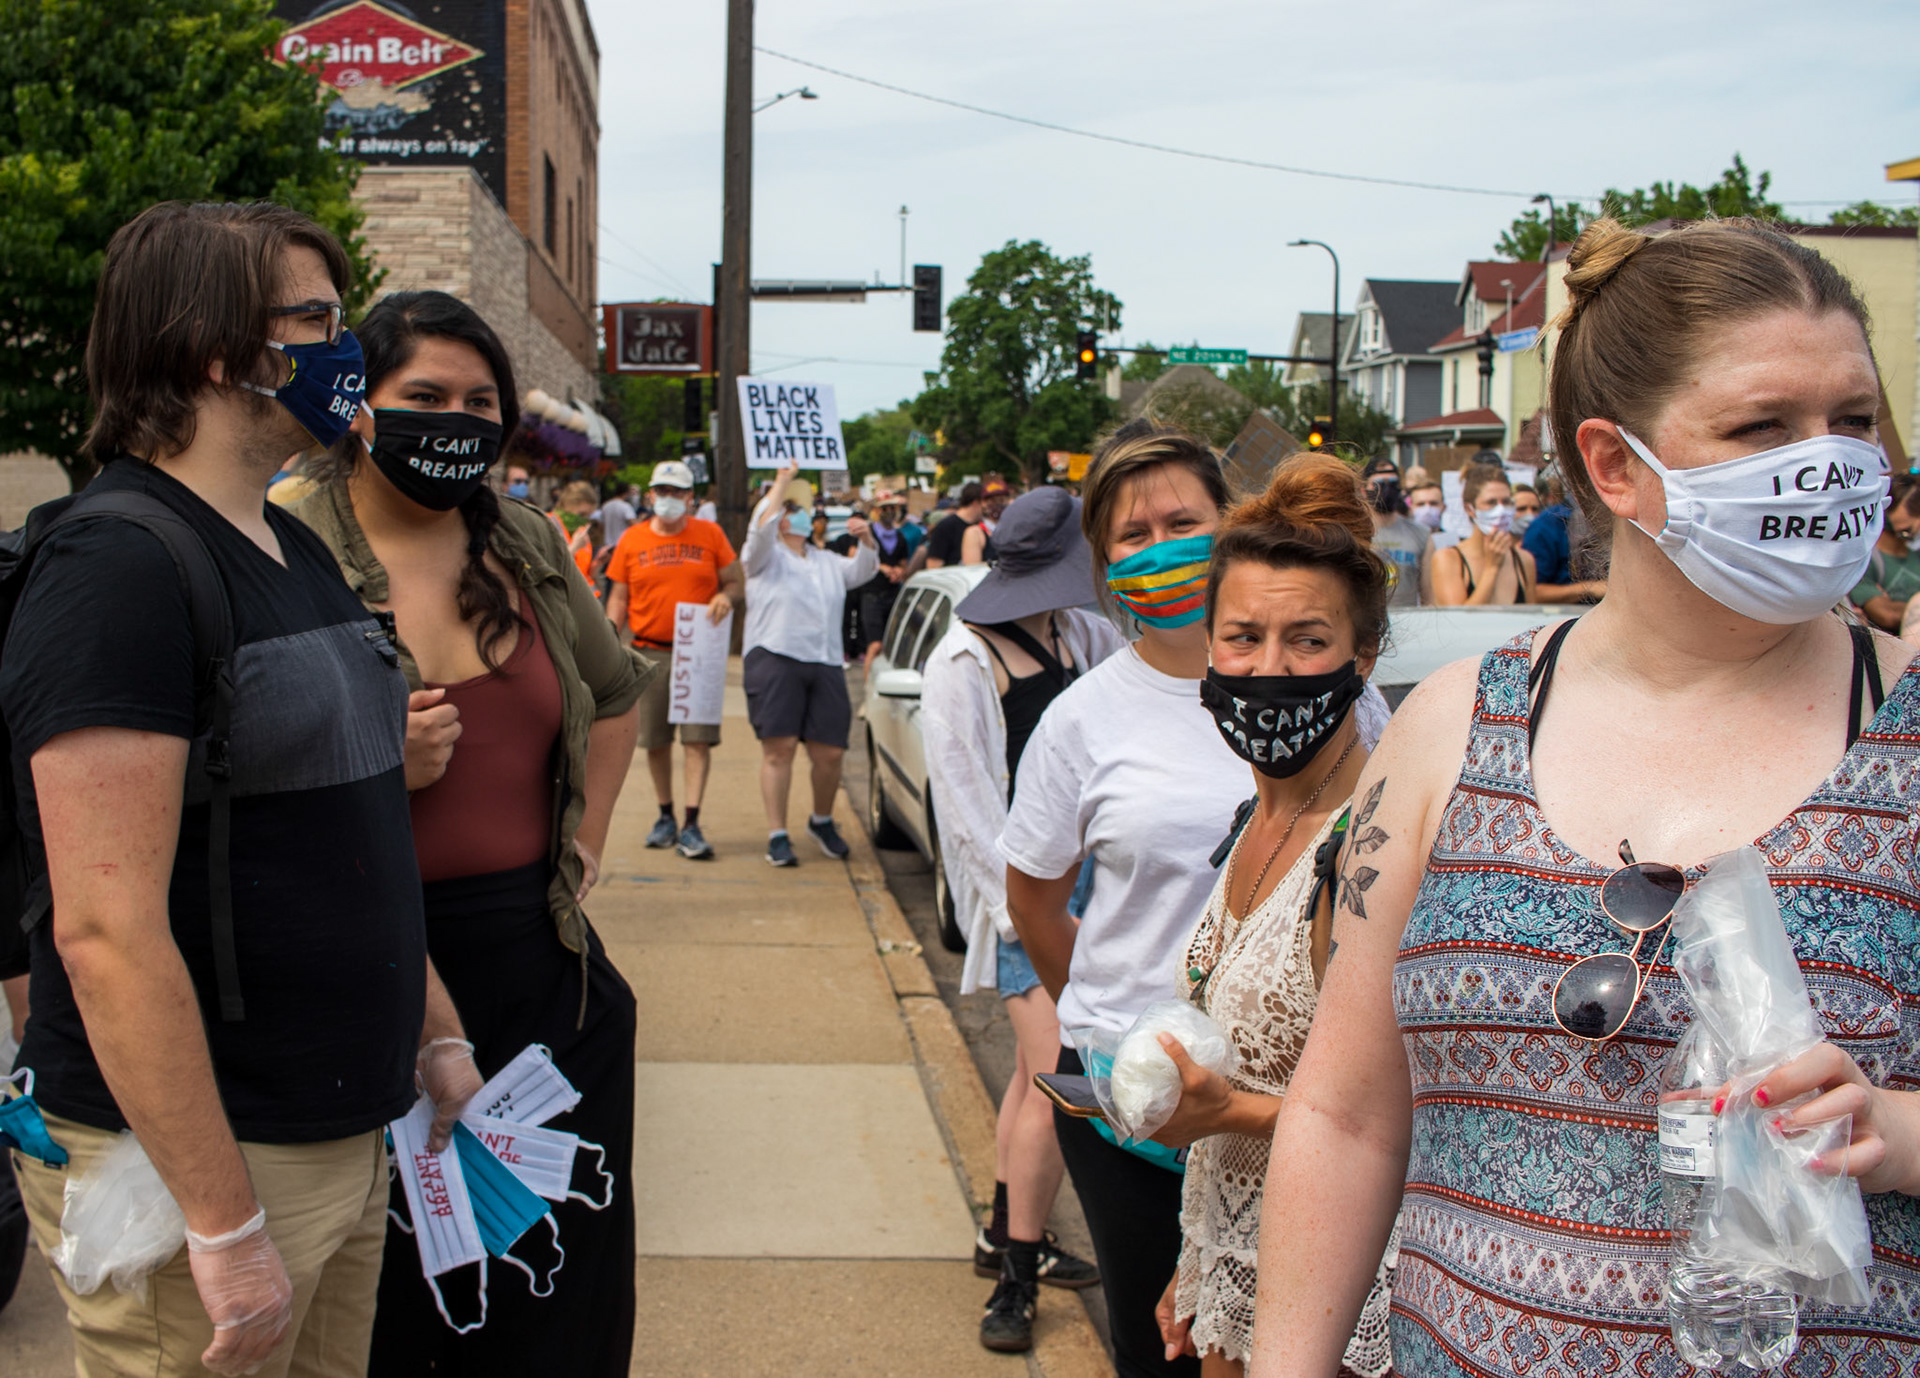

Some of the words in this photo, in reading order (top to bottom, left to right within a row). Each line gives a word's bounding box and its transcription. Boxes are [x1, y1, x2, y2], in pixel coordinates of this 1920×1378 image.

[358, 137, 422, 158] always
[424, 139, 447, 153] on
[633, 314, 683, 338] Jax
[1172, 350, 1187, 362] NE
[332, 372, 342, 390] I
[747, 384, 821, 409] BLACK
[750, 409, 823, 434] LIVES
[419, 436, 428, 450] I
[432, 437, 481, 455] CAN'T
[754, 434, 841, 460] MATTER
[1771, 475, 1782, 496] I
[1794, 461, 1864, 492] CAN'T
[1758, 502, 1879, 542] BREATH
[674, 606, 696, 720] JUSTICE
[1232, 697, 1248, 724] I
[1256, 690, 1334, 732] CAN'T
